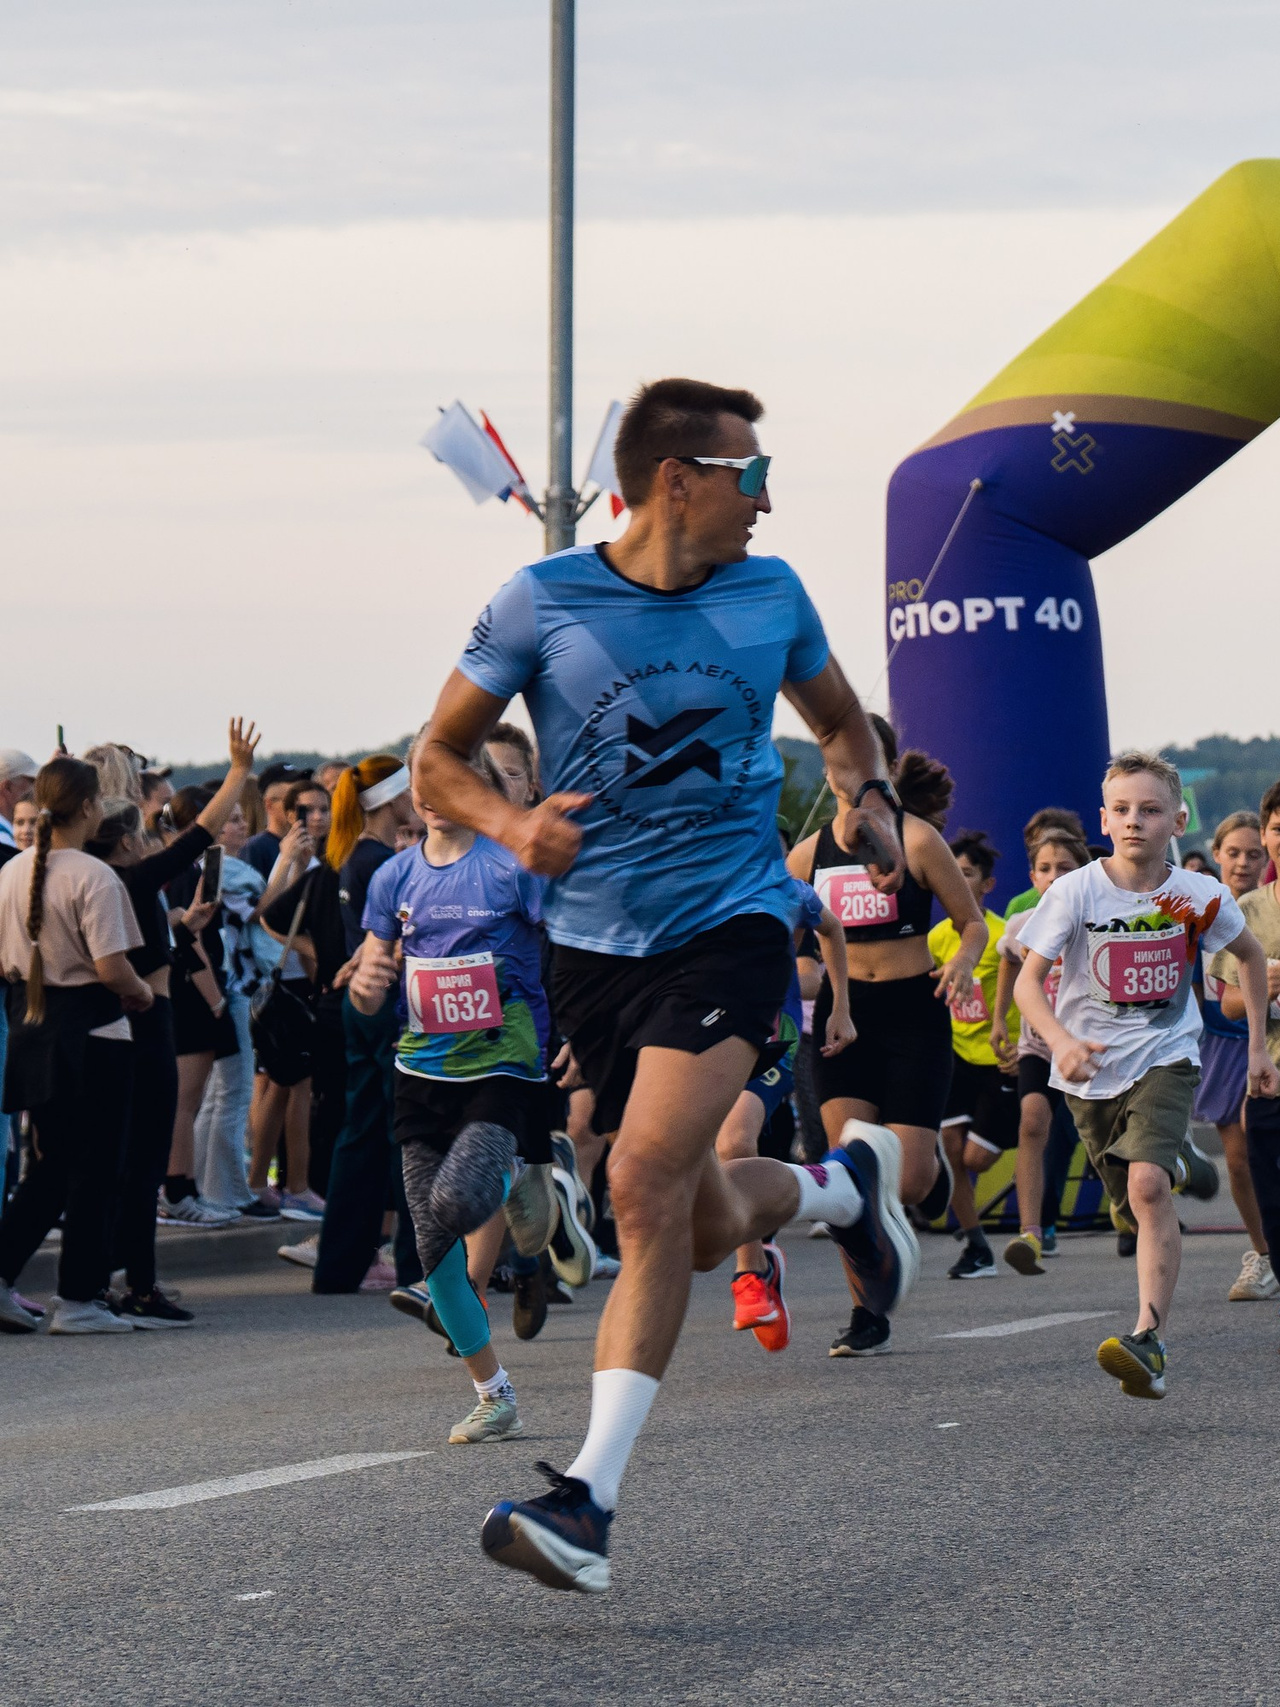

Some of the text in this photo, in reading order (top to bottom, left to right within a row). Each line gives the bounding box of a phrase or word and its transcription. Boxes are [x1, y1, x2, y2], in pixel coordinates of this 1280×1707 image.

[889, 596, 1083, 641] СПОРТ 40
[840, 893, 890, 921] 2035
[1133, 948, 1172, 963] НИКИТА
[436, 973, 472, 989] МАРИЯ
[1123, 961, 1180, 995] 3385
[431, 989, 492, 1023] 1632
